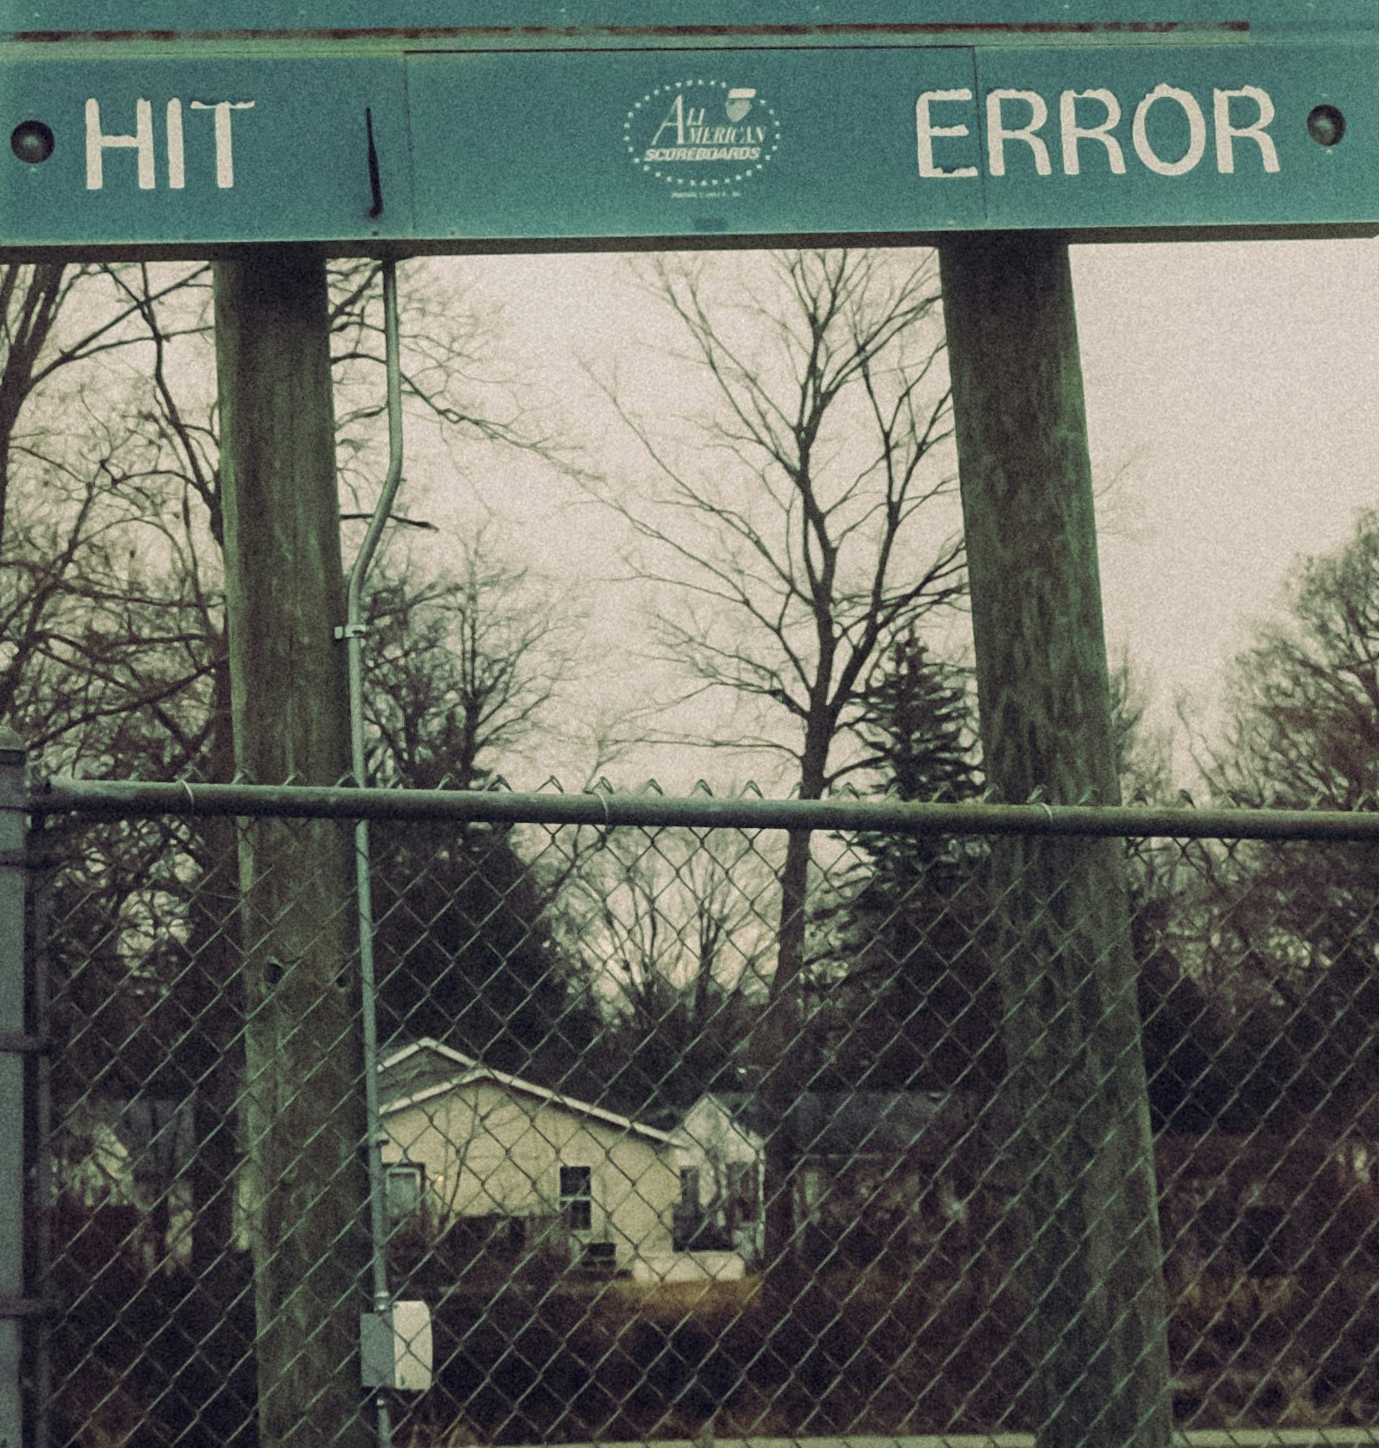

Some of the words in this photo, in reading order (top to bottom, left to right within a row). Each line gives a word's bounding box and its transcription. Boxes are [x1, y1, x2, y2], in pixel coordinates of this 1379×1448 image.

[85, 98, 255, 190] HIT
[644, 147, 762, 162] SCOREBOARDS
[916, 83, 1280, 179] ERROR
